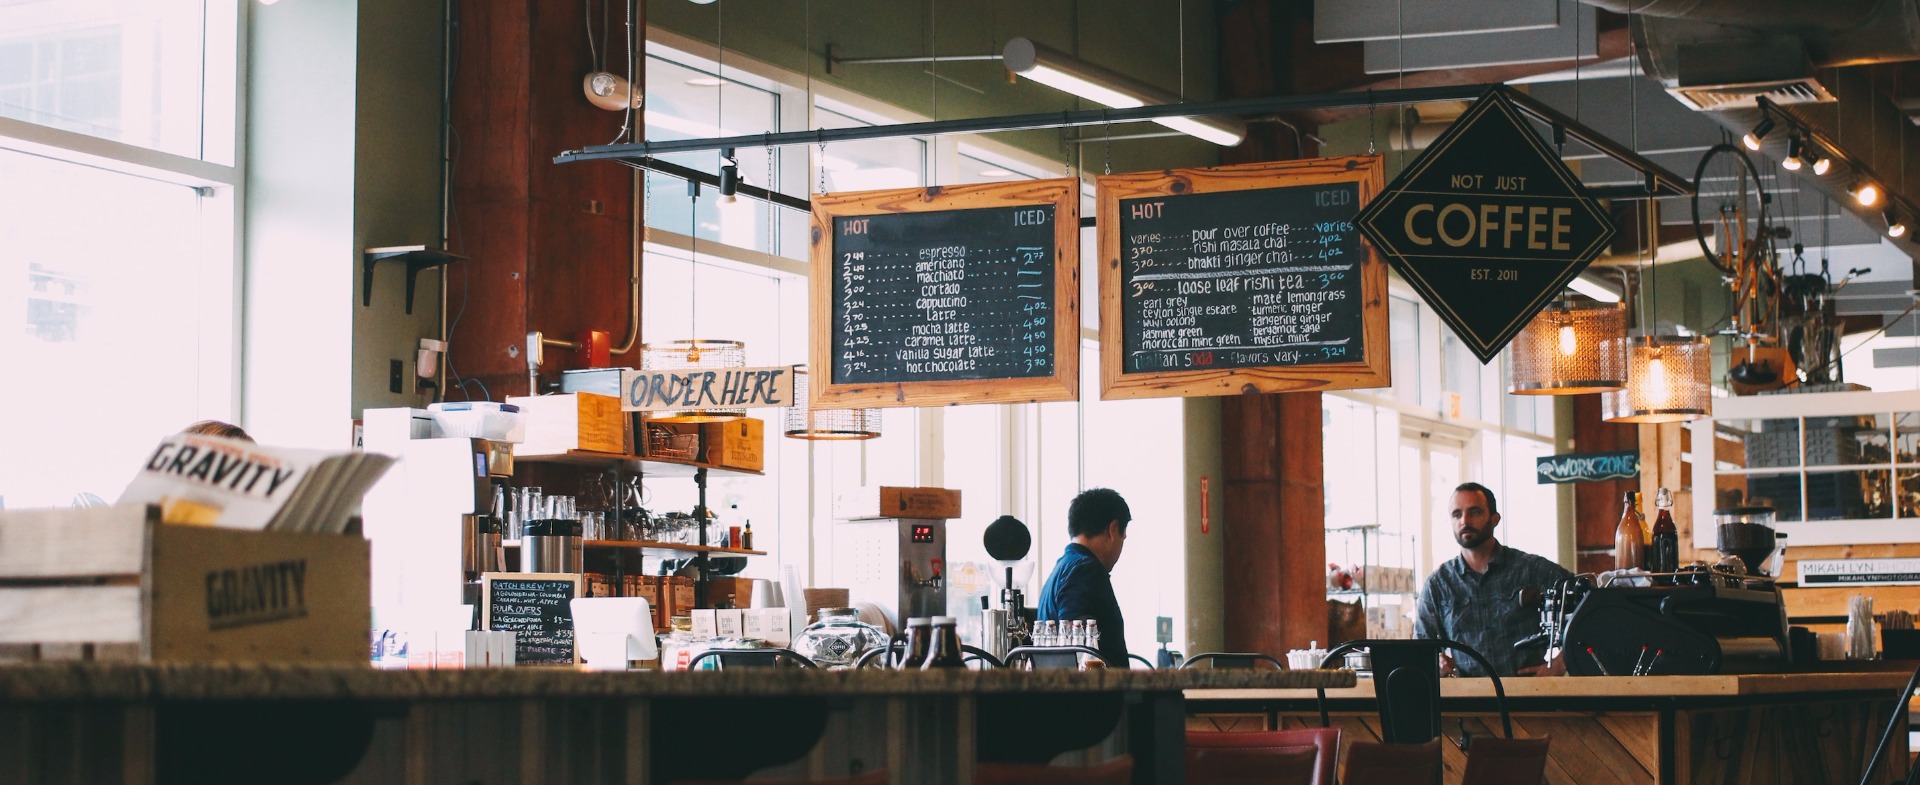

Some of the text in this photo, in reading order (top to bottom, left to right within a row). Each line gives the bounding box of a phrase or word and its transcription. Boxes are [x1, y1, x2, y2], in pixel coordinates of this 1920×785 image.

[1451, 175, 1527, 191] NOT JUST
[1131, 189, 1350, 219] HOT ICED
[844, 210, 1045, 236] HOT ICED
[1404, 203, 1571, 250] COFFEE
[1130, 221, 1354, 244] varies pour over coffee varies
[1193, 241, 1217, 254] rishi
[1220, 239, 1260, 252] masala
[1264, 236, 1286, 249] chai
[919, 246, 966, 261] espresso
[1187, 255, 1221, 270] bhakti
[1224, 252, 1263, 268] ginger
[1266, 250, 1293, 264] chai
[915, 258, 965, 272] americano
[916, 270, 964, 284] macchiato
[1471, 269, 1518, 281] EST. 2011
[921, 283, 960, 297] cortado
[1178, 281, 1211, 295] loose
[1216, 277, 1240, 293] leaf
[1244, 275, 1274, 291] rishi
[1279, 274, 1305, 290] tea
[915, 296, 967, 310] cappuccino
[1143, 296, 1188, 309] earl grey
[1287, 290, 1346, 304] lemongrass
[926, 309, 956, 321] latte
[1143, 304, 1238, 319] ceylon single estate
[1251, 302, 1323, 315] turmeric ginger
[1166, 316, 1196, 327] oolong
[1252, 312, 1332, 327] tangerine ginger
[912, 323, 941, 336] mocha
[944, 322, 970, 334] latte
[1142, 327, 1203, 340] jasmine green
[1253, 323, 1321, 336] bergamot sage
[904, 335, 945, 347] caramel
[949, 334, 976, 346] latte
[1142, 334, 1241, 349] moroccan mint green
[1254, 333, 1310, 346] mystic mint
[895, 348, 929, 360] vanilla
[933, 347, 964, 361] sugar
[968, 345, 995, 358] latte
[1135, 353, 1178, 369] italian
[1184, 351, 1213, 367] soda
[1230, 351, 1269, 363] flavors
[1273, 351, 1299, 364] vary
[906, 361, 923, 373] hot
[925, 359, 976, 373] chocolate
[630, 370, 784, 407] ORDER HERE
[147, 442, 294, 498] GRAVITY
[1552, 455, 1634, 476] WORK ZONE
[1803, 563, 1844, 573] MIKAH
[1849, 562, 1874, 573] LYN
[206, 558, 306, 618] GRAVITY
[492, 581, 517, 590] BATCH
[520, 582, 546, 591] BREW
[492, 603, 542, 615] POUR OVERS
